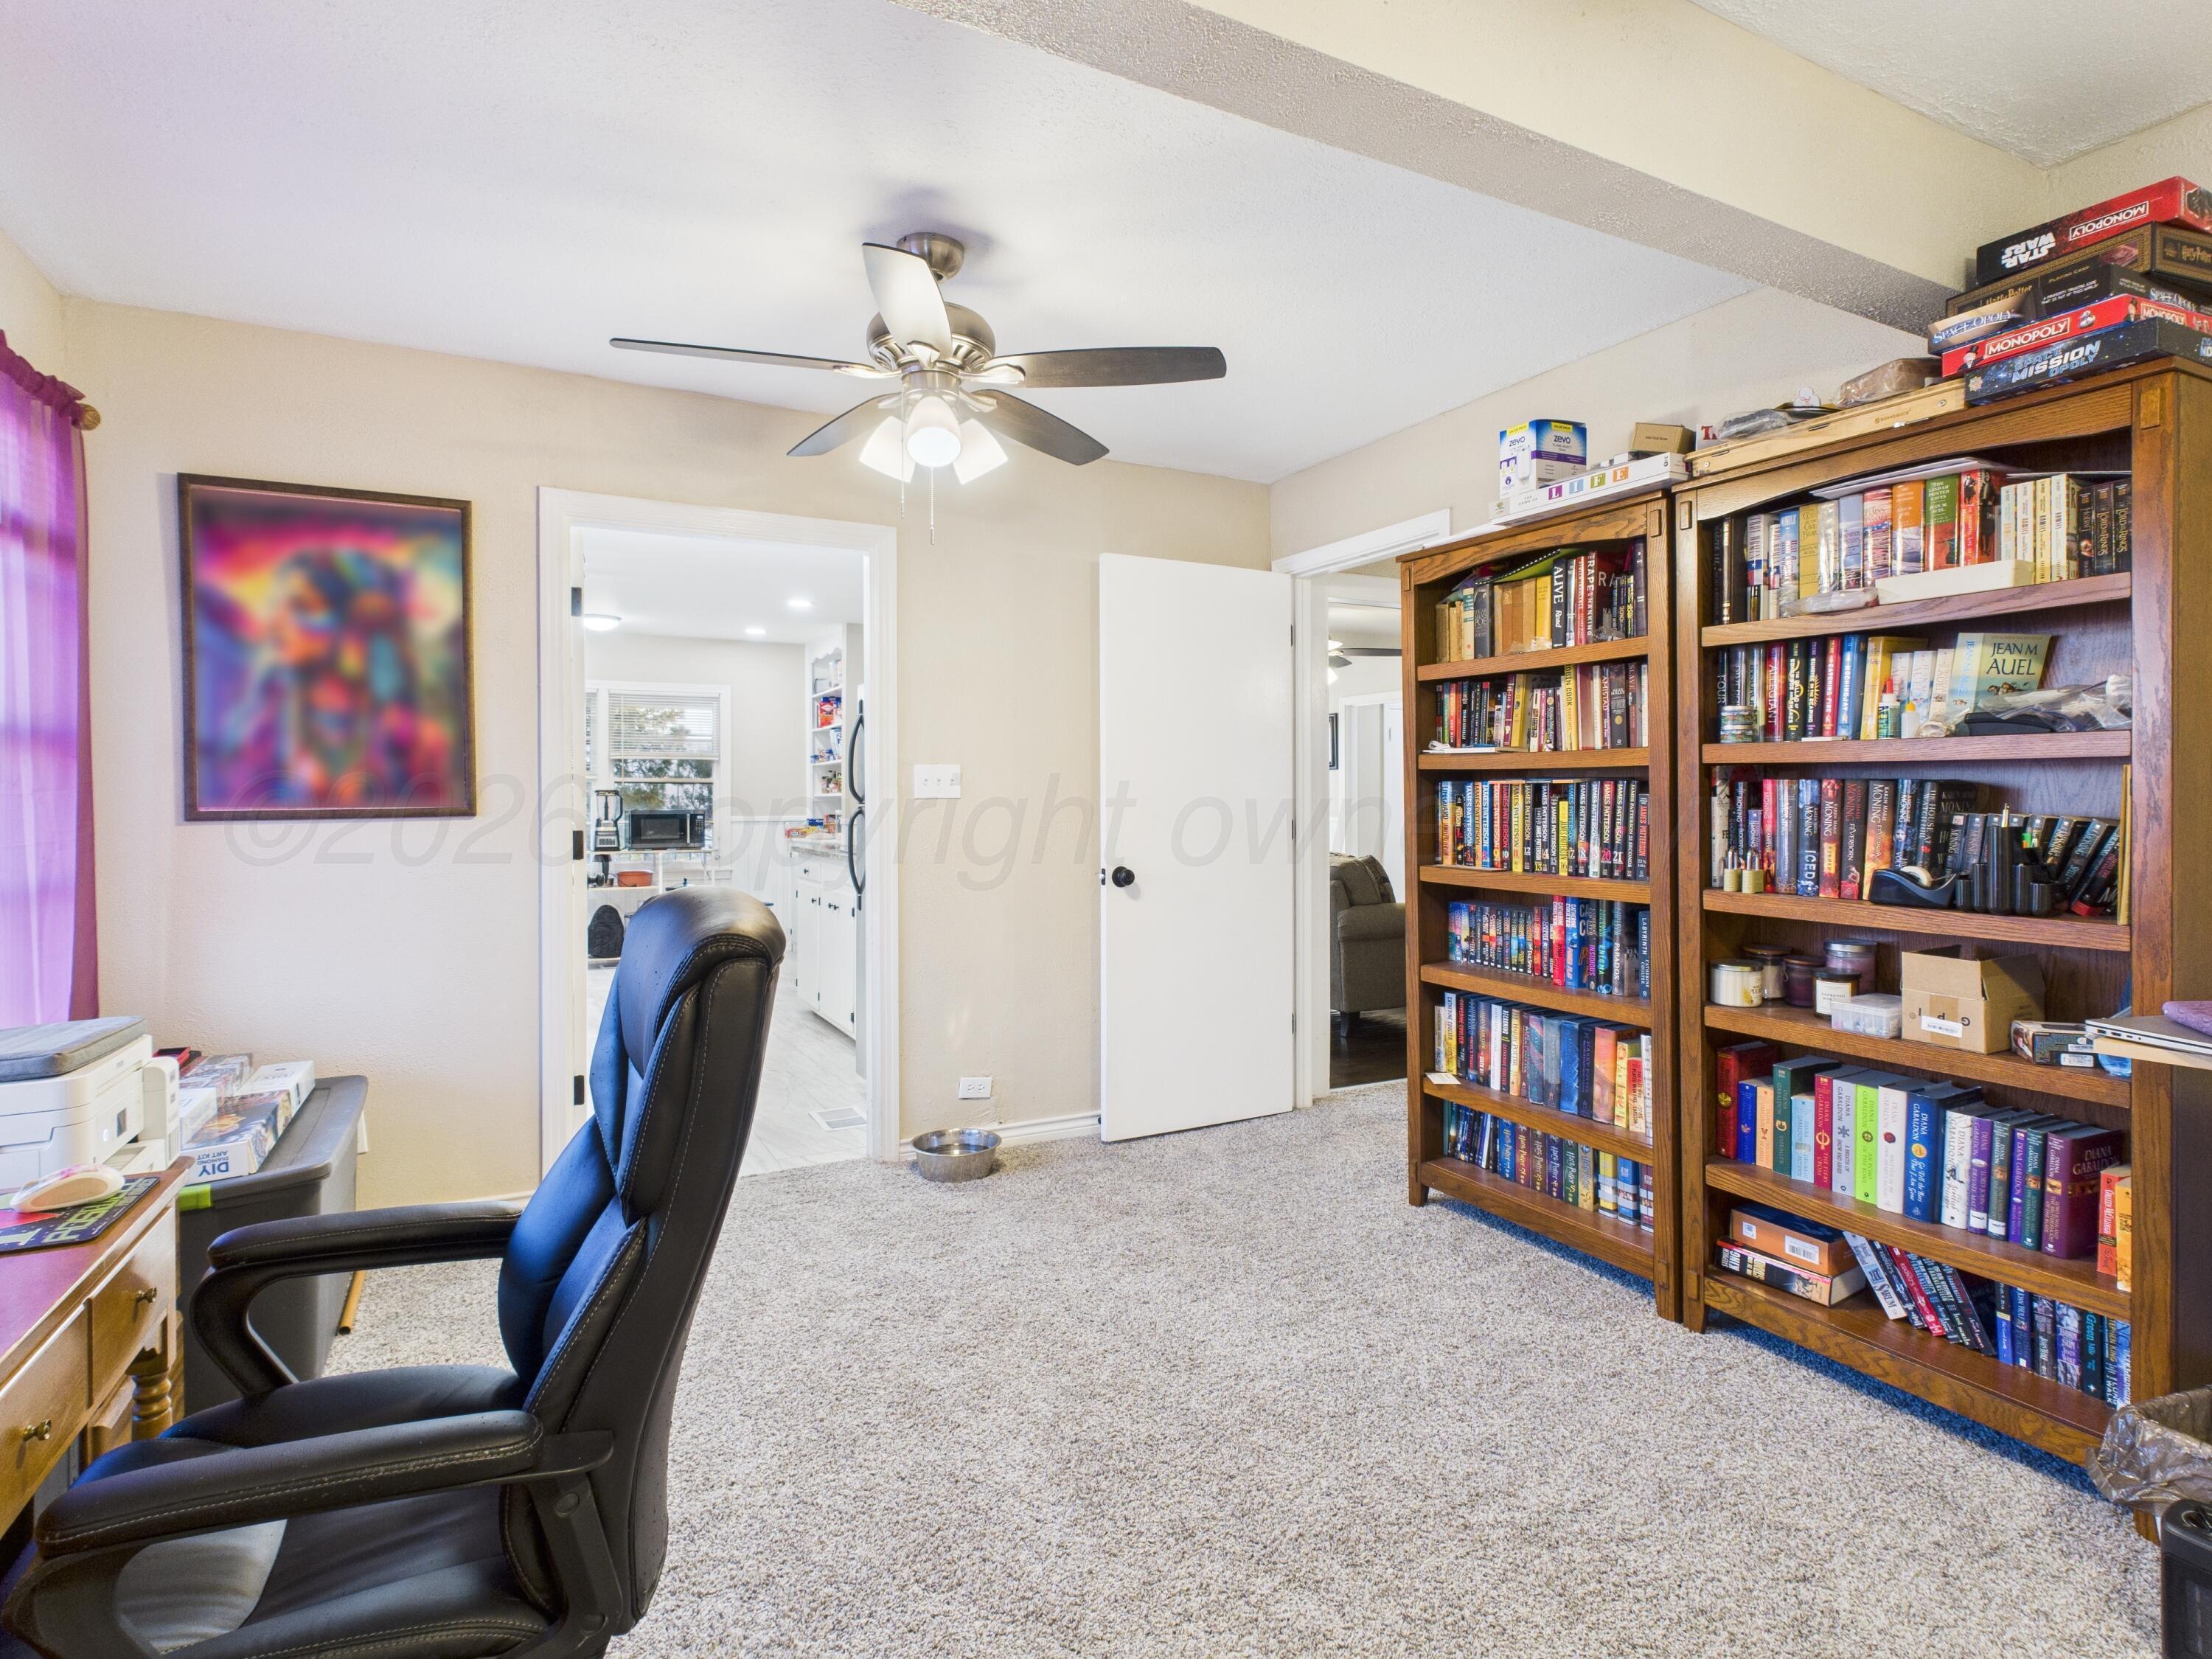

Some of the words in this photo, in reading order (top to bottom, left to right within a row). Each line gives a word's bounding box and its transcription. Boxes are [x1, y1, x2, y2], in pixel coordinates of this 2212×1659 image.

[2072, 203, 2146, 237] MONOPOLY
[2001, 240, 2056, 269] STAR
[2003, 232, 2056, 259] WARS
[1988, 322, 2067, 355] MONOPOLY
[2011, 341, 2101, 383] MISSION
[2049, 352, 2100, 377] OPOLY
[1509, 436, 1526, 447] zevo
[1554, 434, 1571, 444] zevo
[2098, 511, 2110, 529] LORD
[2115, 507, 2129, 526] LORD
[2097, 533, 2110, 557] RINGS
[2115, 530, 2129, 553] RINGS
[1554, 566, 1563, 604] ALIVE
[1586, 560, 1595, 592] RAPE
[1474, 618, 1487, 627] POE
[1554, 610, 1562, 628] Read
[1586, 597, 1594, 636] NANKING
[1991, 642, 2024, 658] JEAN
[2025, 644, 2038, 655] M
[1628, 664, 1636, 690] SLAVE
[1809, 658, 1817, 682] SUNRISE
[1986, 658, 2037, 675] AUEL
[1717, 674, 1726, 704] FOUR
[1825, 664, 1834, 696] CATCHING
[1841, 665, 1851, 712] MOCKINGJAY
[1601, 675, 1609, 712] AMISTAD
[1768, 665, 1778, 726] ALLEGIANT
[1845, 783, 1857, 821] MONING
[1898, 794, 1907, 823] MONING
[1615, 806, 1623, 844] PATTERSON
[1639, 805, 1647, 824] JAMES
[1781, 802, 1789, 835] MONING
[1804, 805, 1814, 836] MONING
[1926, 804, 1936, 832] HOUSE
[1501, 807, 1509, 847] PATTERSON
[1559, 820, 1568, 835] JAMES
[1523, 846, 1531, 855] 12
[1542, 847, 1549, 858] 14
[1559, 835, 1568, 860] PATTERSON
[1638, 826, 1646, 856] PATTERSON
[1847, 824, 1857, 861] FEVERBORN
[1923, 835, 1932, 846] AT
[2048, 830, 2067, 858] MONING
[1502, 850, 1509, 858] 10
[1601, 850, 1612, 862] 20
[1613, 851, 1624, 862] 21
[1804, 849, 1817, 880] ICED
[1534, 863, 1543, 872] 13
[1598, 945, 1606, 975] ENIGMA
[1512, 1044, 1520, 1067] POTTER
[1911, 1103, 1921, 1141] GABALDON
[1919, 1113, 1929, 1135] DIANA
[1503, 1129, 1512, 1143] Harry
[1518, 1134, 1526, 1149] Harry
[1533, 1141, 1543, 1155] Harry
[1947, 1118, 1956, 1164] GABALDON
[1957, 1130, 1966, 1157] DIANA
[1972, 1122, 1981, 1156] GABALDON
[1980, 1130, 1989, 1151] DIANA
[197, 1158, 229, 1166] DIAMOND
[212, 1150, 228, 1158] ART
[1504, 1144, 1512, 1161] Potter
[1519, 1150, 1527, 1169] Potter
[1550, 1146, 1559, 1161] Harry
[1566, 1151, 1576, 1167] Harry
[1993, 1136, 2001, 1165] GABALDON
[2016, 1141, 2025, 1161] DIANA
[2027, 1145, 2035, 1174] GABALDON
[2084, 1144, 2113, 1161] DIANA
[198, 1161, 229, 1178] DIY
[1533, 1155, 1543, 1174] Potter
[1550, 1161, 1559, 1180] Potter
[1567, 1166, 1576, 1183] Potter
[1918, 1161, 1926, 1170] Go
[2048, 1149, 2056, 1178] GABALDON
[1917, 1172, 1925, 1182] Tell
[2014, 1162, 2024, 1196] GABALDON
[1916, 1191, 1924, 1203] Bees
[1950, 1185, 1958, 1211] Scottish
[1721, 1248, 1729, 1268] STEPHEN
[1729, 1250, 1741, 1272] KING
[1900, 1262, 1915, 1287] KOONTZ'S
[1873, 1284, 1897, 1310] SARUM
[1952, 1312, 1963, 1326] lost
[1958, 1326, 1970, 1346] souls
[2085, 1314, 2097, 1341] Green
[2088, 1342, 2096, 1355] Mile
